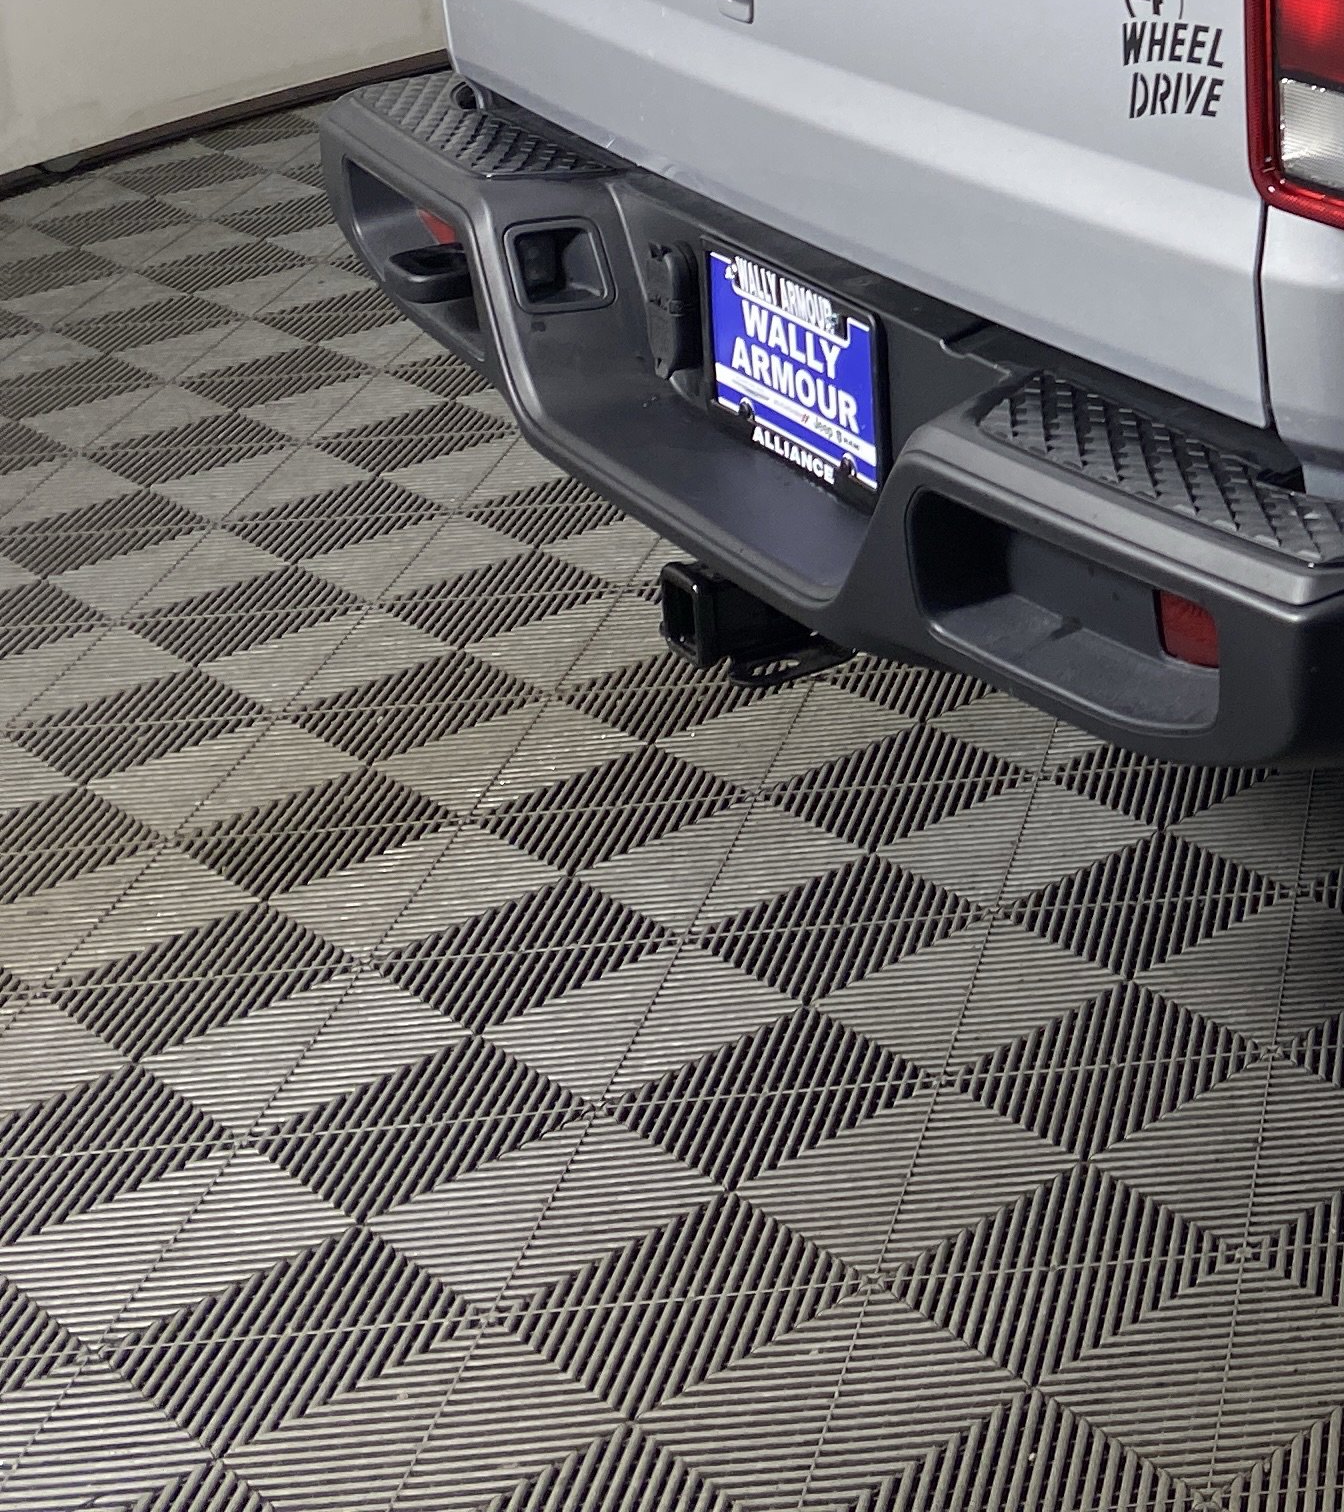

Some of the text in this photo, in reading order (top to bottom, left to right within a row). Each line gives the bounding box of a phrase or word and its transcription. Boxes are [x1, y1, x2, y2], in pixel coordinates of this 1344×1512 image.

[1122, 20, 1225, 69] WHEEL
[1129, 71, 1225, 119] DRIVE
[734, 255, 835, 336] WALLY ARMOUR
[741, 298, 842, 380] WALLY
[731, 336, 860, 435] ARMOUR
[752, 425, 836, 486] ALLIANCE
